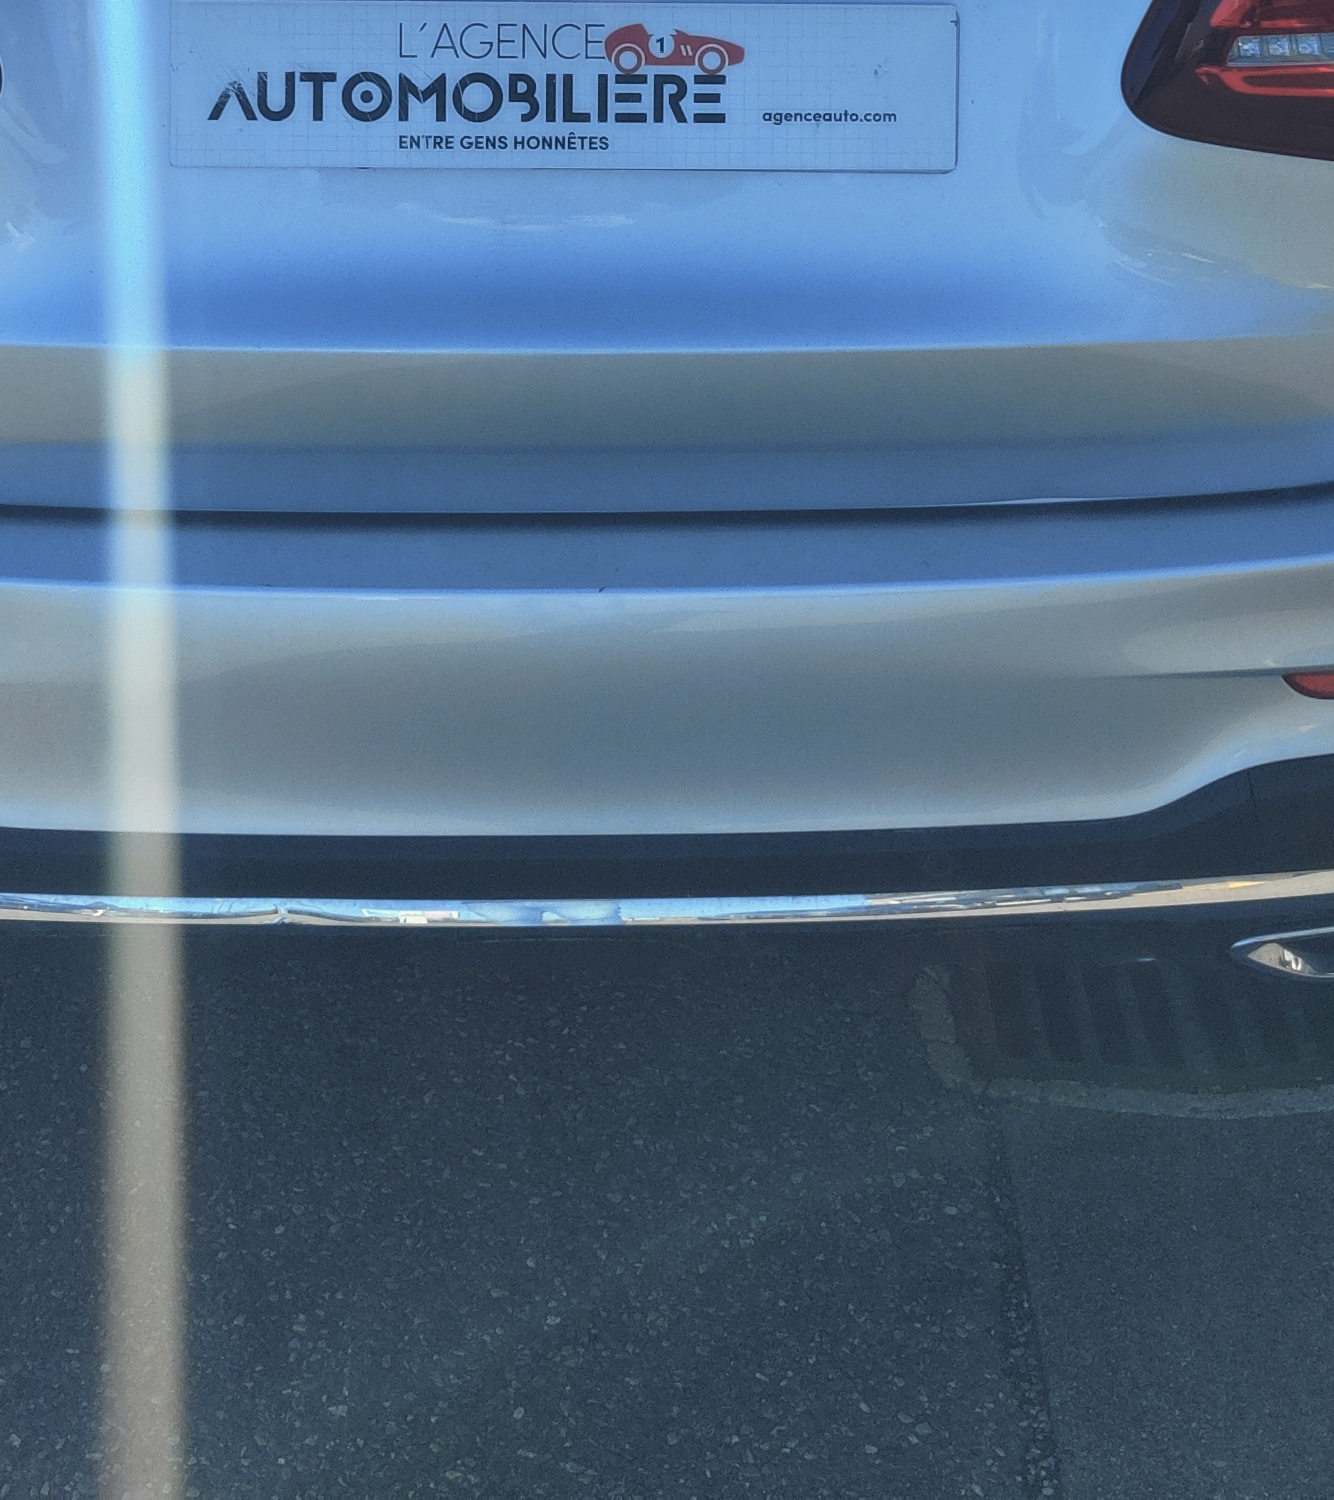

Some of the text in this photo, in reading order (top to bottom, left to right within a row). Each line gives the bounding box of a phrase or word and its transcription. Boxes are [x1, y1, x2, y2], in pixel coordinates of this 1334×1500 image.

[398, 23, 606, 59] L'AGENCE
[655, 36, 665, 54] 1
[762, 110, 897, 125] agenceauto.com
[398, 131, 610, 151] ENTRE GENS HONNÊTES
